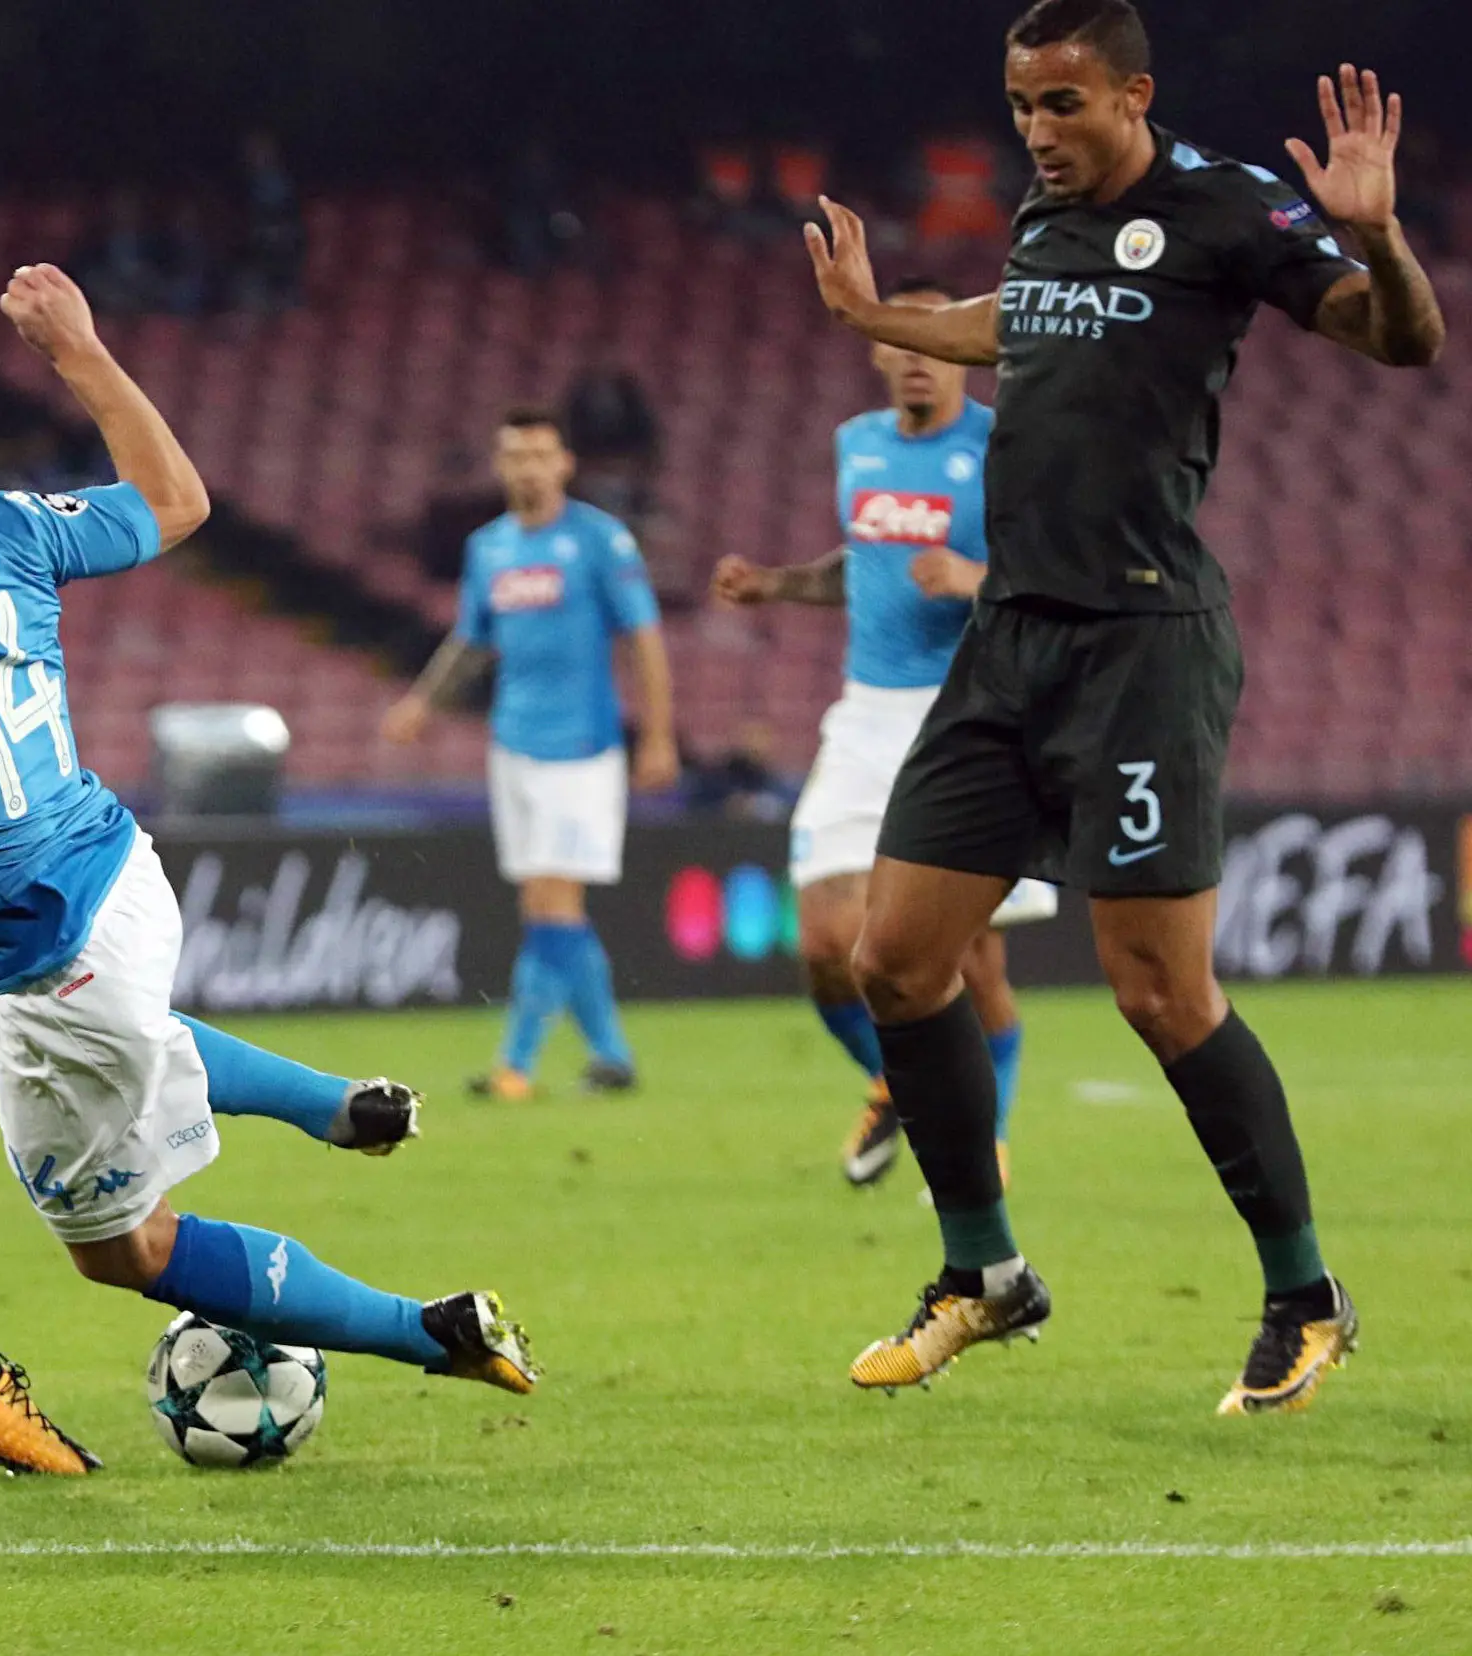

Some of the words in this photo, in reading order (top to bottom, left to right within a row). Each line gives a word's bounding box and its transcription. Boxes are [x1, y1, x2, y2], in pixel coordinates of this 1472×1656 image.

[999, 280, 1154, 322] ETIHAD
[1010, 316, 1106, 341] AIRWAYS
[1117, 761, 1161, 842] 3
[173, 852, 462, 1008] hildren
[166, 1120, 212, 1149] Kap
